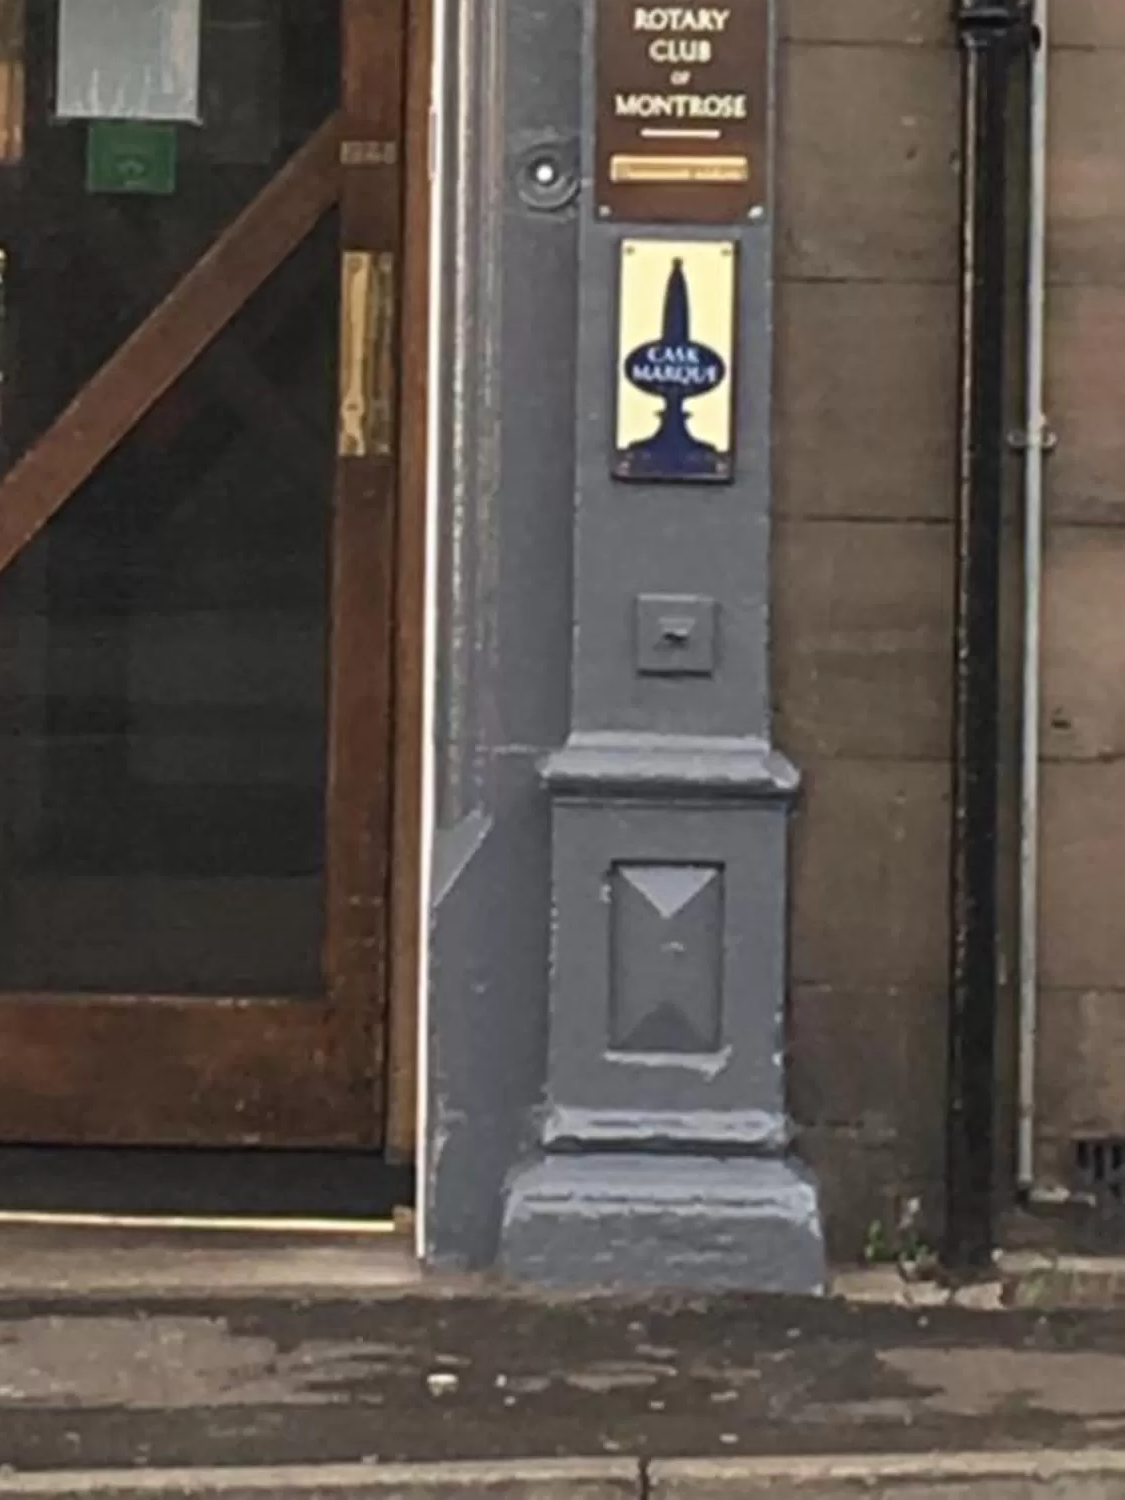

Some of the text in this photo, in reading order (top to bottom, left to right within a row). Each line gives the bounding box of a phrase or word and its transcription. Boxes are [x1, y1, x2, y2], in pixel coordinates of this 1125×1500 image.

[634, 8, 730, 31] ROTARY
[649, 40, 711, 62] CLUB
[615, 94, 747, 118] MONTROSE
